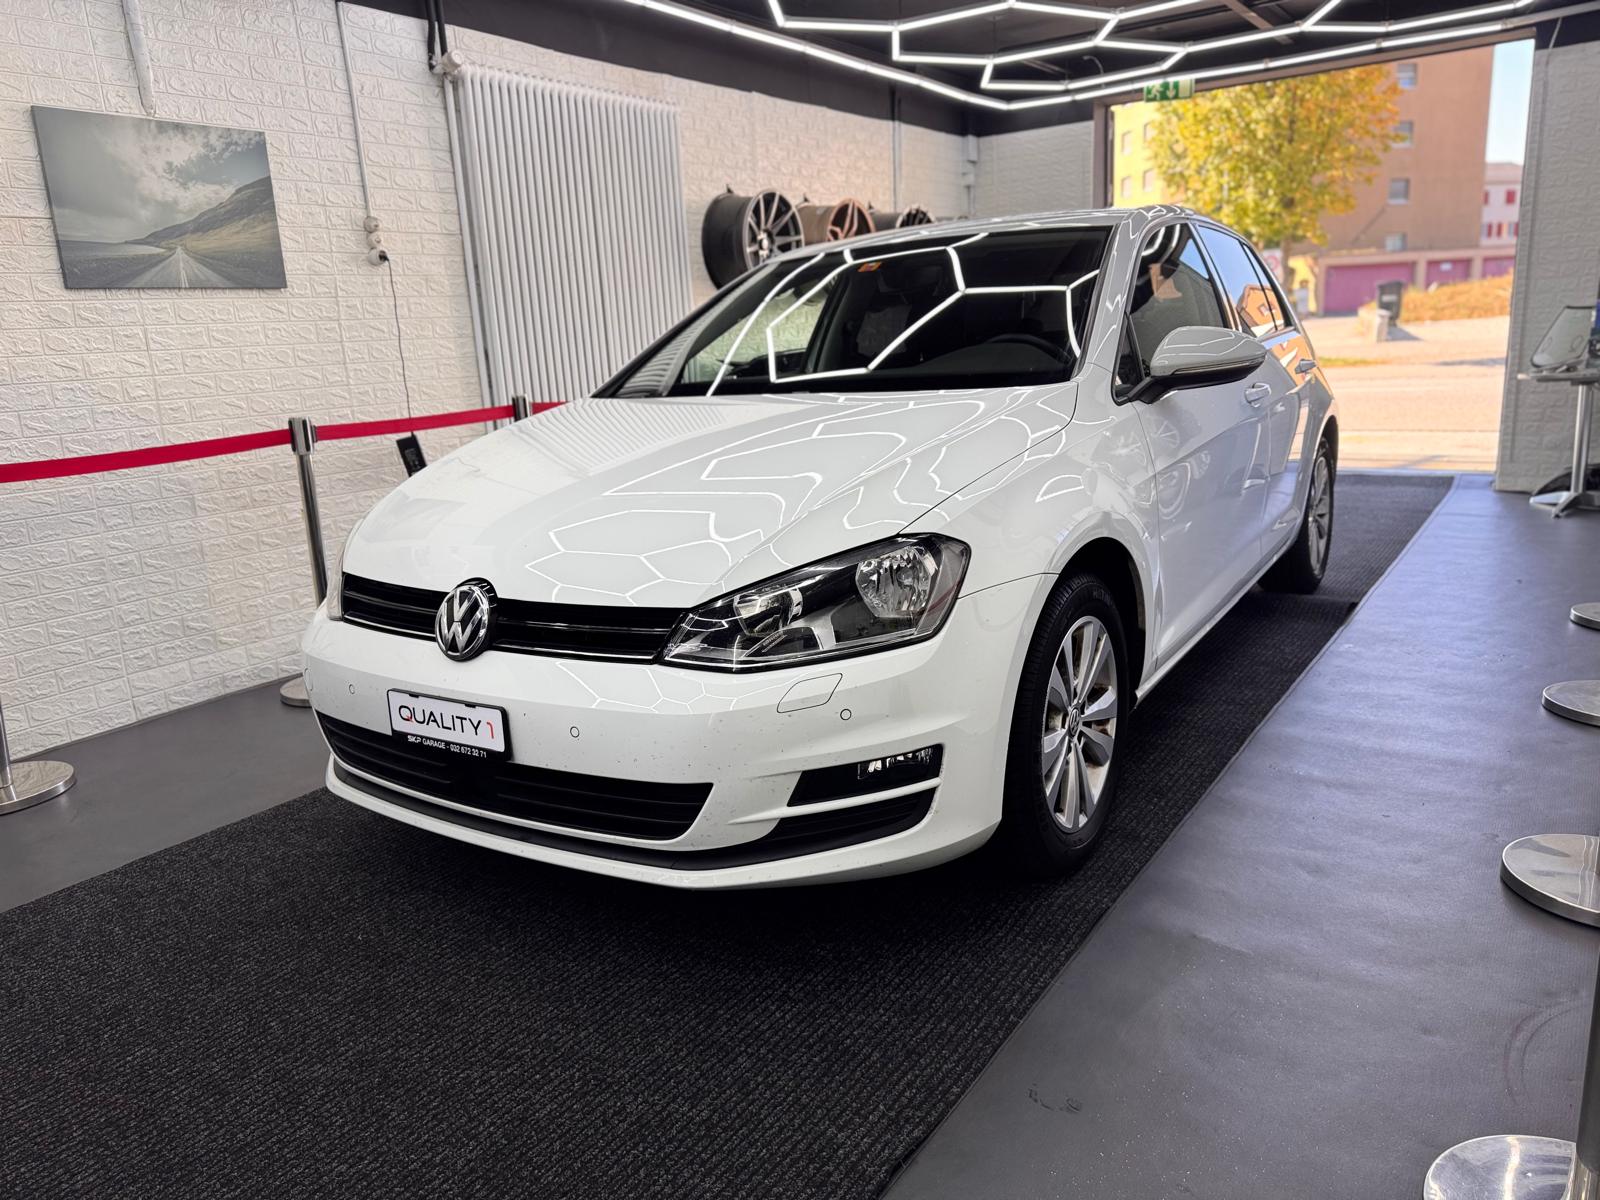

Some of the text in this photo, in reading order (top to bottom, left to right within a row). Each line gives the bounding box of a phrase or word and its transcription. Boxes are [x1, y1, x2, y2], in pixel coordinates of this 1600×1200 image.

[436, 586, 488, 657] VW
[399, 705, 494, 739] QUALITY 1
[422, 738, 445, 749] GARAGE
[450, 744, 460, 753] 032
[472, 748, 479, 757] 32
[480, 750, 487, 758] 71
